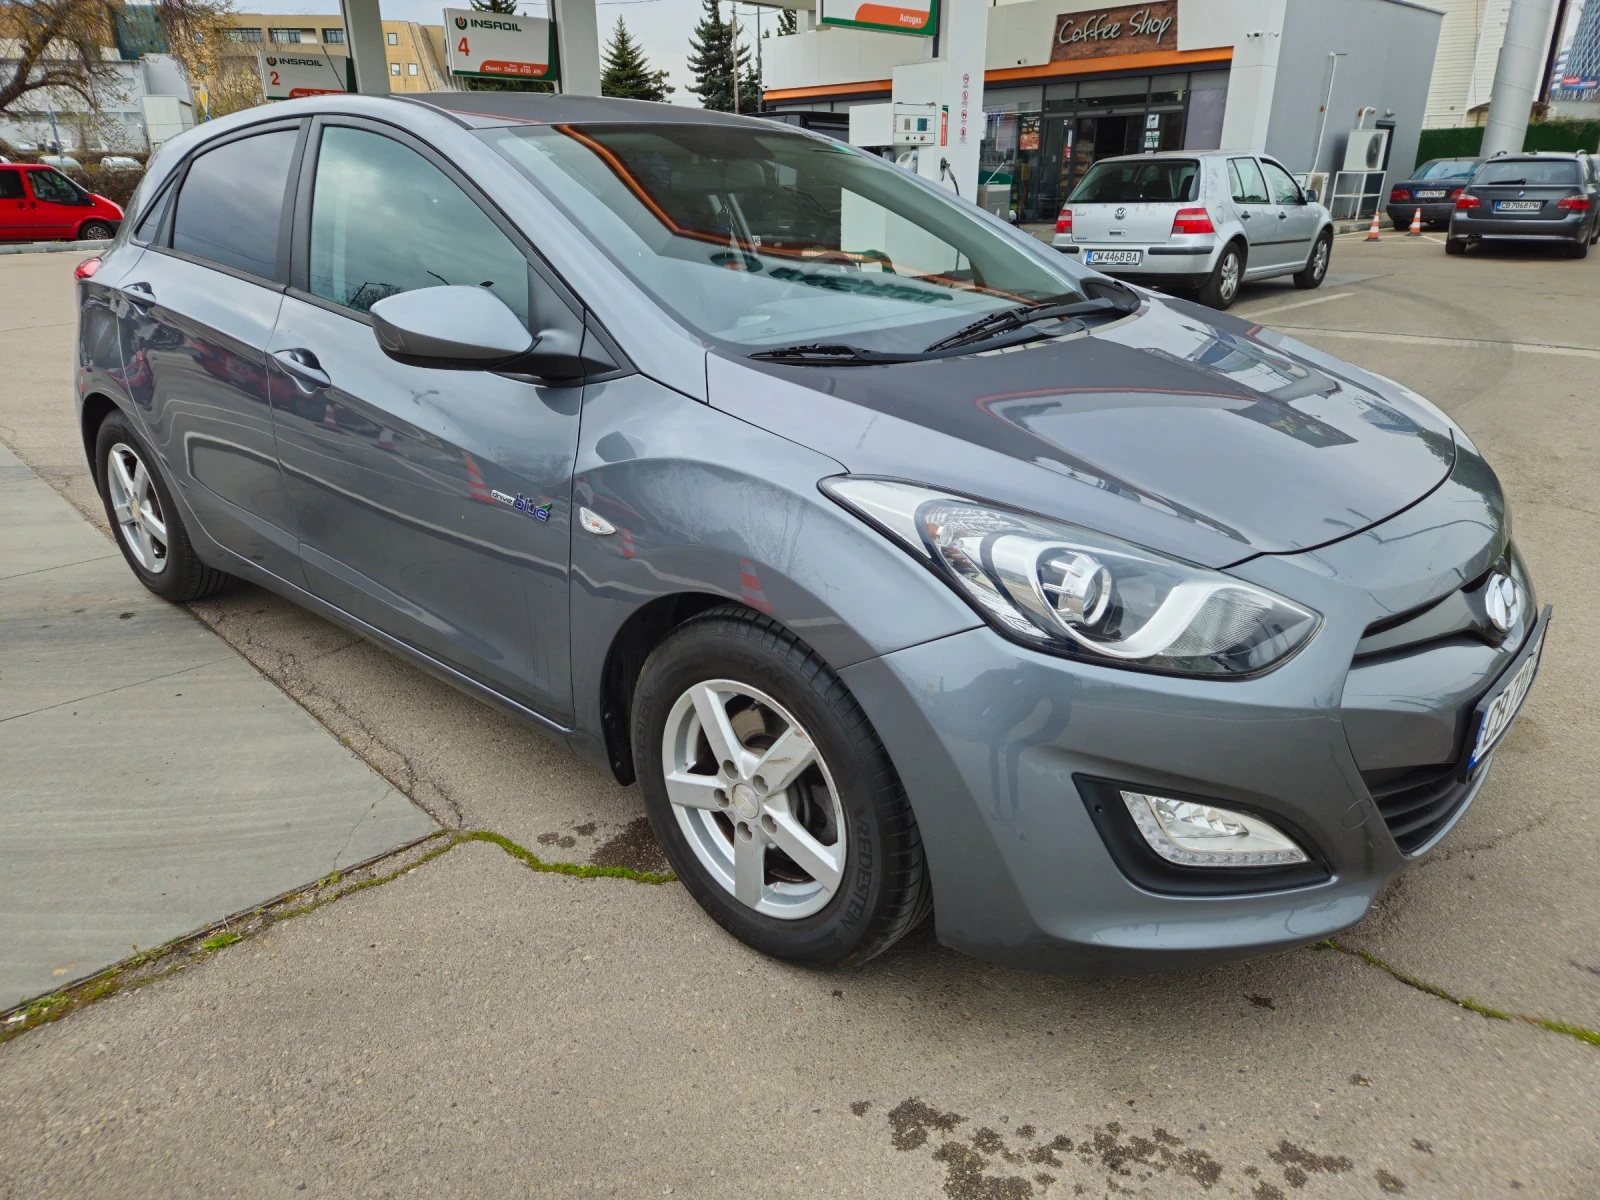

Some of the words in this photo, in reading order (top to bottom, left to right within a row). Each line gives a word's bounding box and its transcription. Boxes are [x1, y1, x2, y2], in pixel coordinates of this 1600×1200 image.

[470, 18, 522, 32] INSAOIL
[899, 13, 922, 25] Autogas
[1059, 14, 1121, 44] Coffee
[1129, 8, 1173, 44] Shop
[457, 37, 470, 57] 4
[279, 57, 323, 67] INSAOIL
[269, 71, 281, 86] 2
[1092, 252, 1104, 262] CM
[1104, 252, 1125, 262] 4468
[1125, 252, 1137, 262] BA
[492, 492, 513, 505] drive
[513, 492, 549, 522] blue
[840, 805, 872, 932] VREDESTEIN
